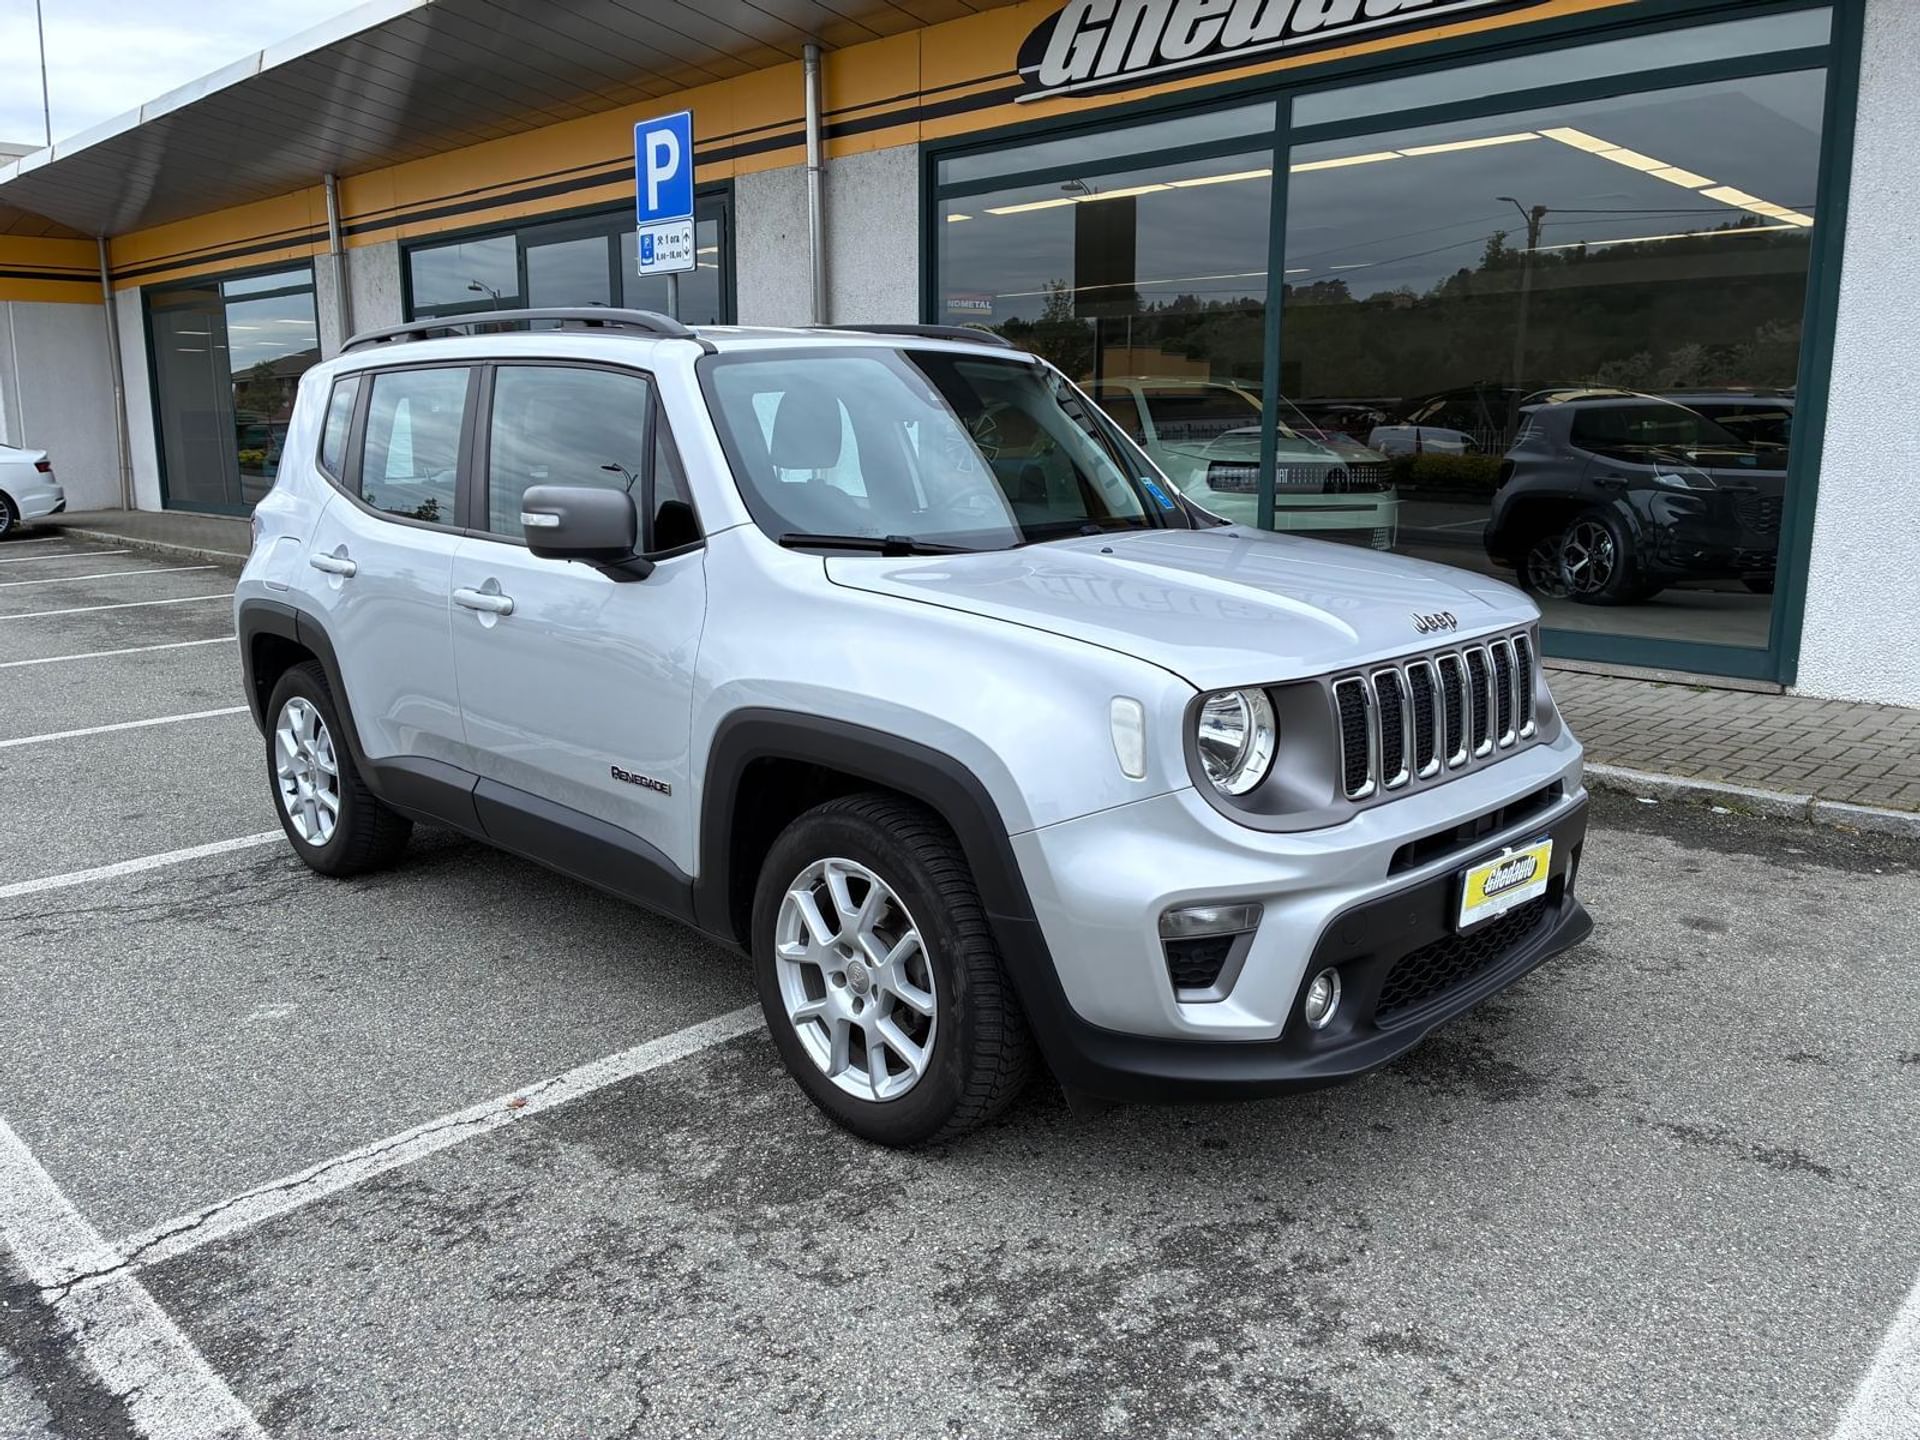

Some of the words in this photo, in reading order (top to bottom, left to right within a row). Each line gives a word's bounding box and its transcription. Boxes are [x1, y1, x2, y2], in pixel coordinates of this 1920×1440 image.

[645, 128, 680, 211] P
[1410, 611, 1457, 635] Jeep
[611, 765, 672, 796] RENEGADE
[1484, 856, 1536, 894] Ghedauto
